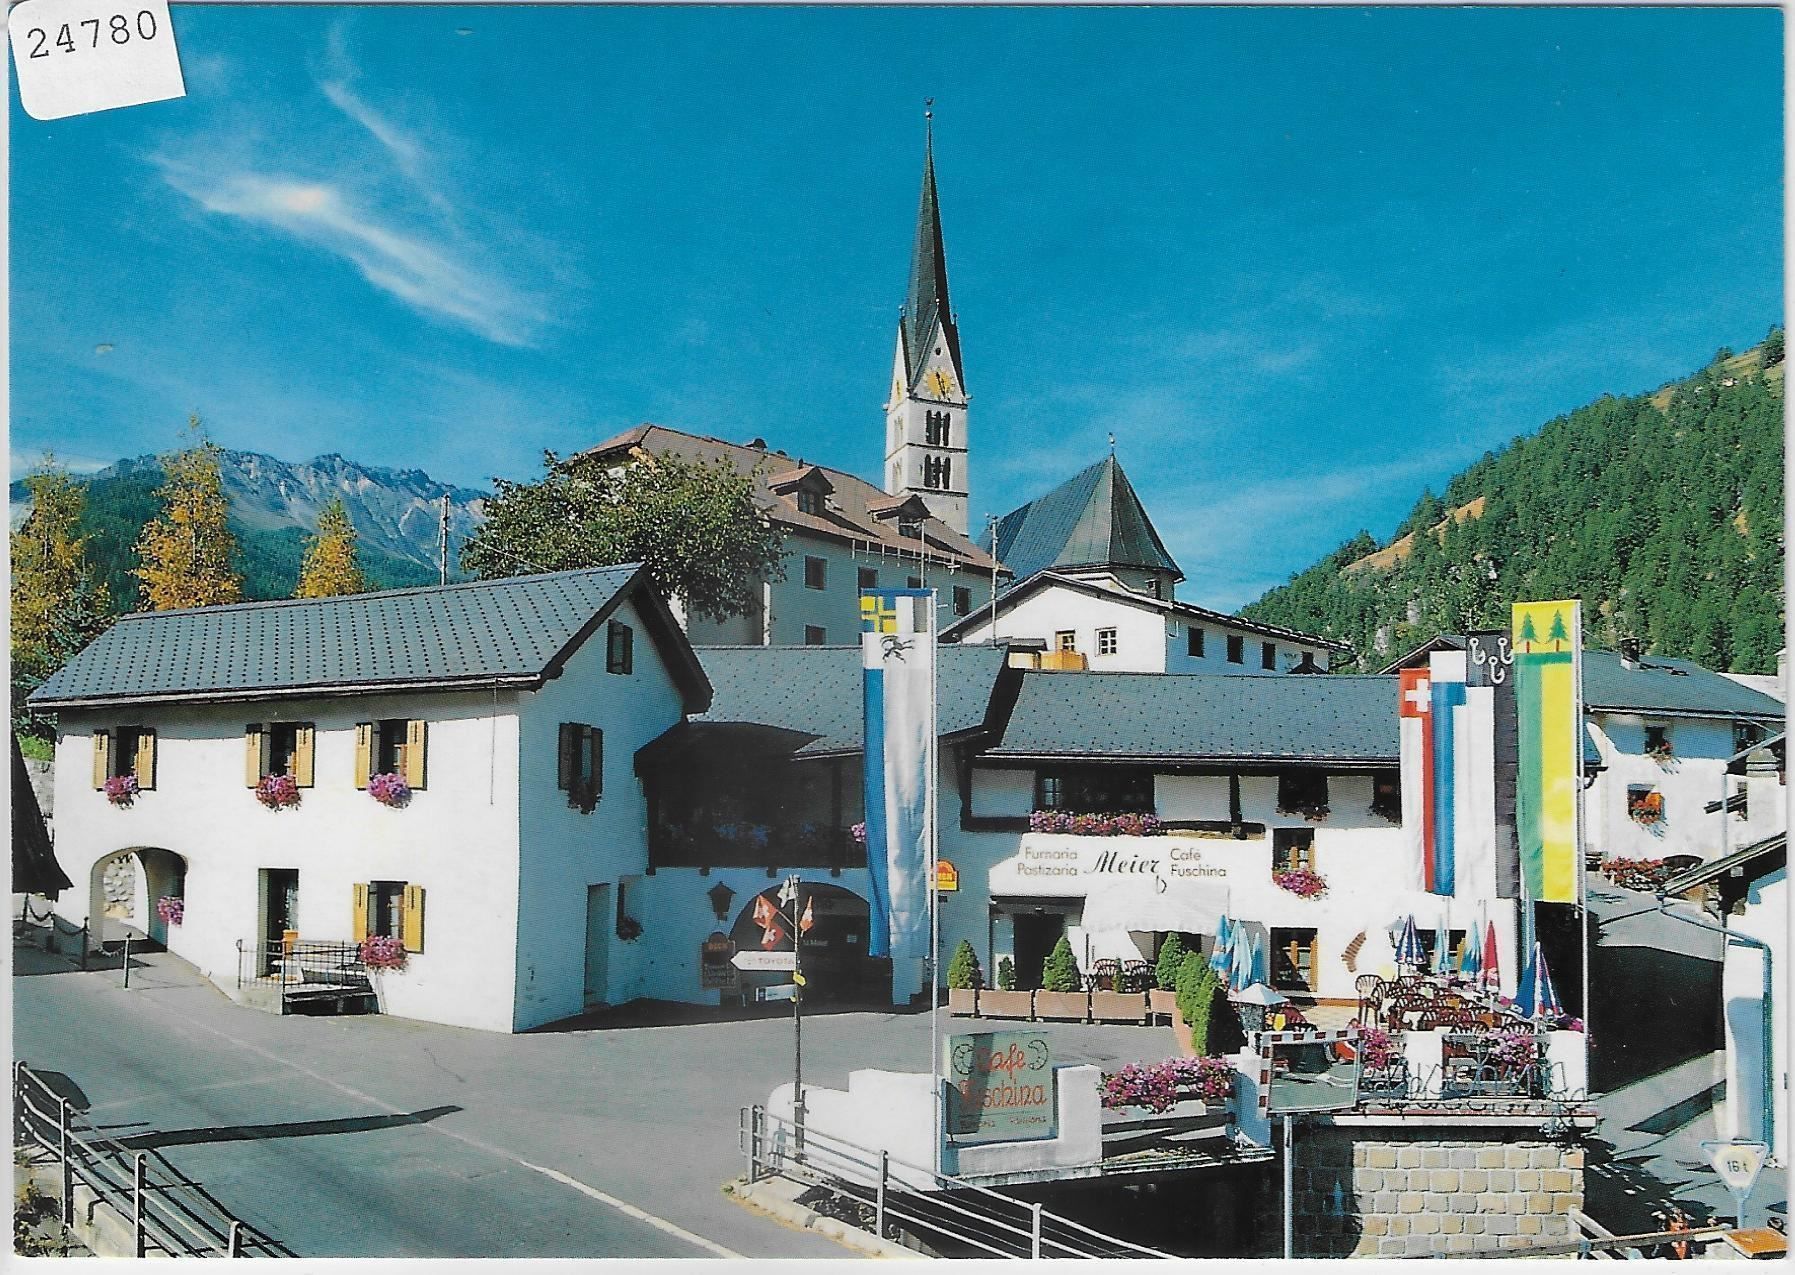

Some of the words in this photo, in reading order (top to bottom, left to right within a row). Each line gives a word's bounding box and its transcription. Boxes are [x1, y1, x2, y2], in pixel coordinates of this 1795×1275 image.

[1024, 846, 1078, 860] Furnaria
[1017, 862, 1078, 876] Pastizaria
[1083, 850, 1161, 875] Meier
[1170, 863, 1227, 877] Fuschina
[1727, 1160, 1740, 1173] 16
